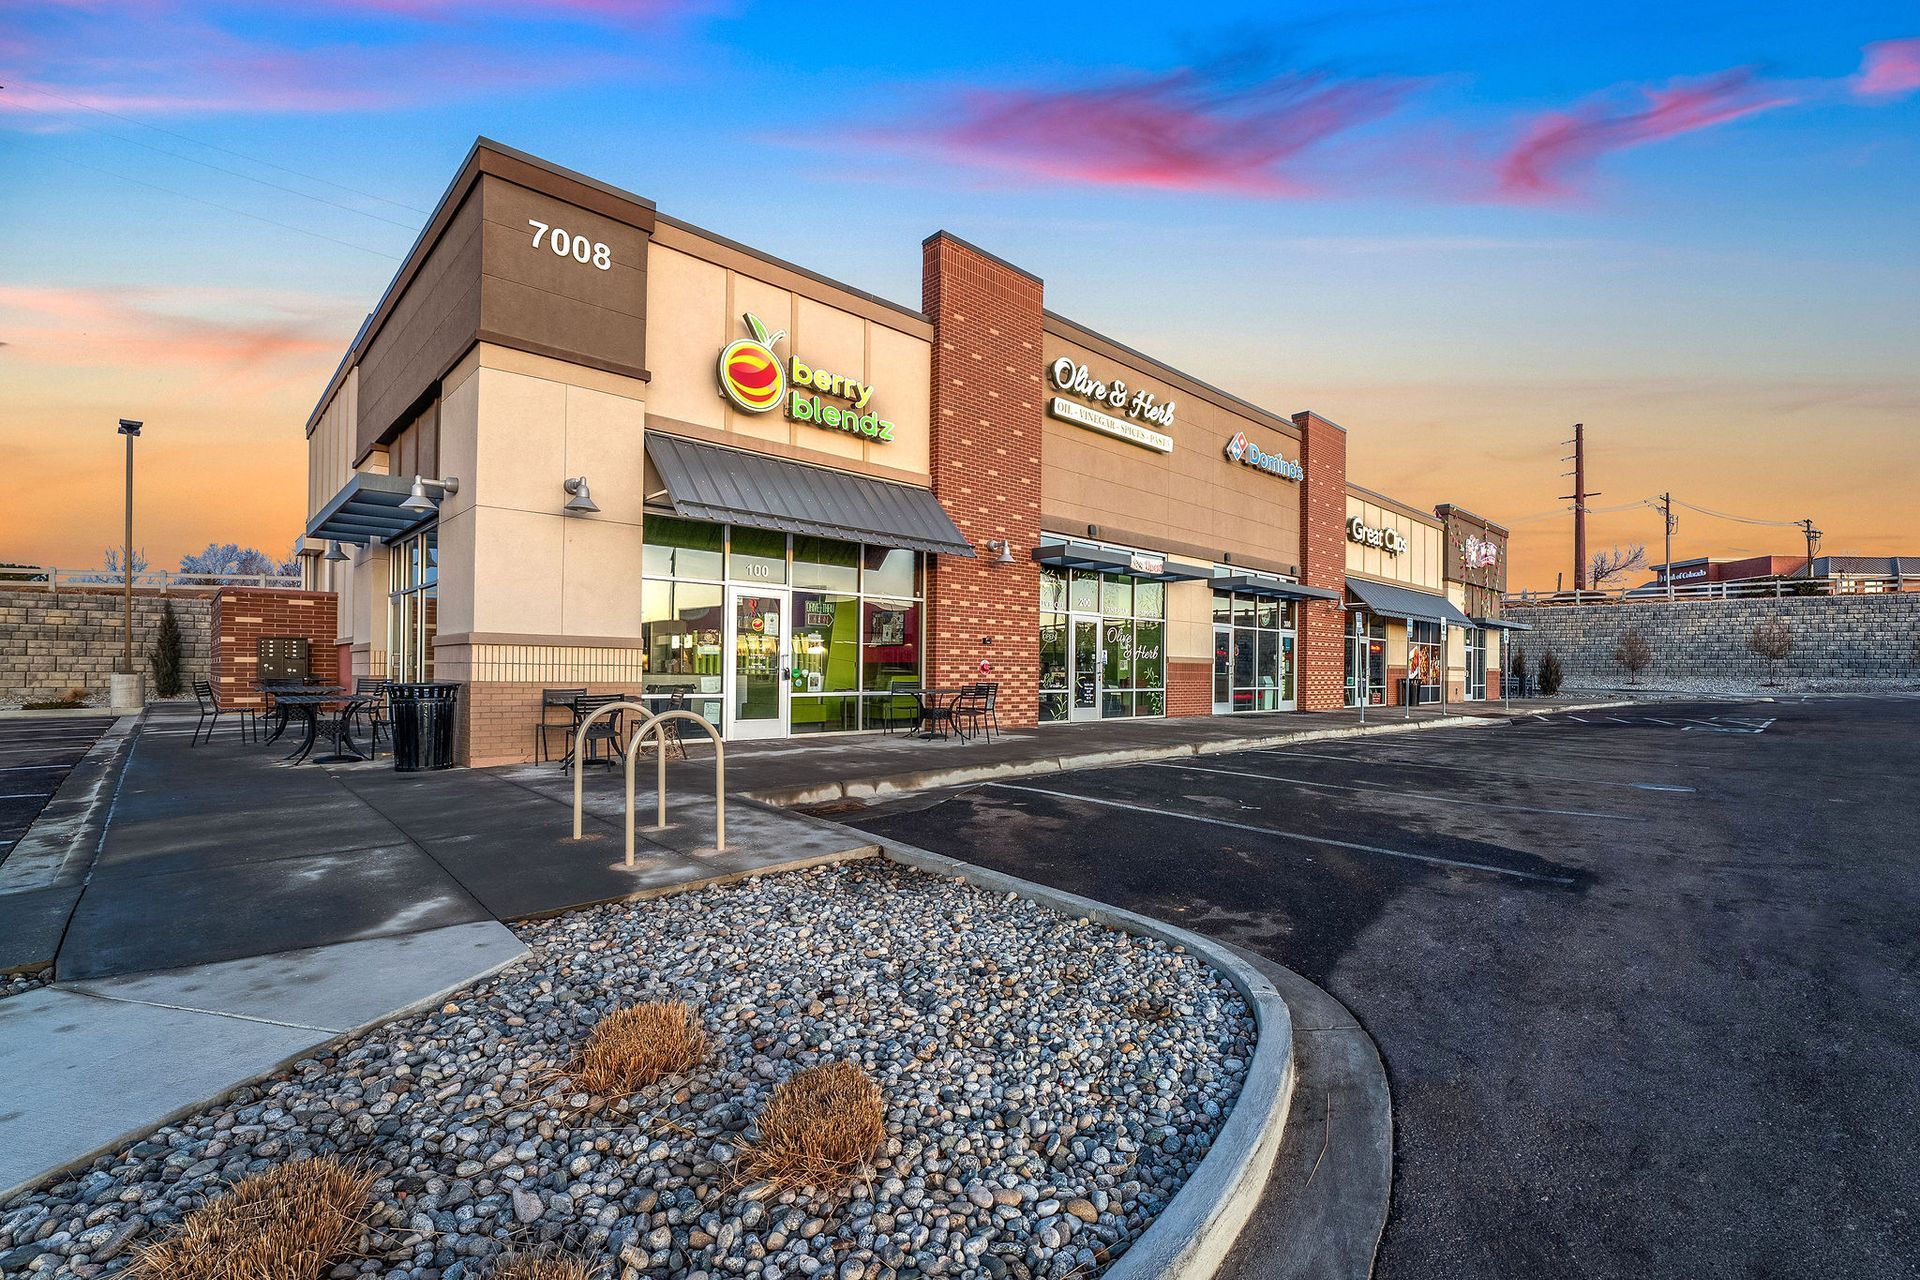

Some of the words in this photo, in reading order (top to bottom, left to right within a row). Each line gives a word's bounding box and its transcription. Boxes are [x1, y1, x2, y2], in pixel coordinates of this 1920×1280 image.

[528, 218, 612, 271] 7008
[791, 354, 875, 409] berry
[1054, 356, 1107, 401] Olive
[1109, 380, 1128, 408] &
[1129, 389, 1176, 427] Herb
[791, 390, 896, 442] blendz
[1057, 402, 1073, 416] OIL
[1248, 442, 1304, 482] Domino's
[1352, 517, 1384, 548] Great
[1385, 528, 1408, 558] Clips
[746, 564, 769, 578] 100
[1107, 627, 1132, 644] Olive
[1134, 645, 1159, 661] Herb
